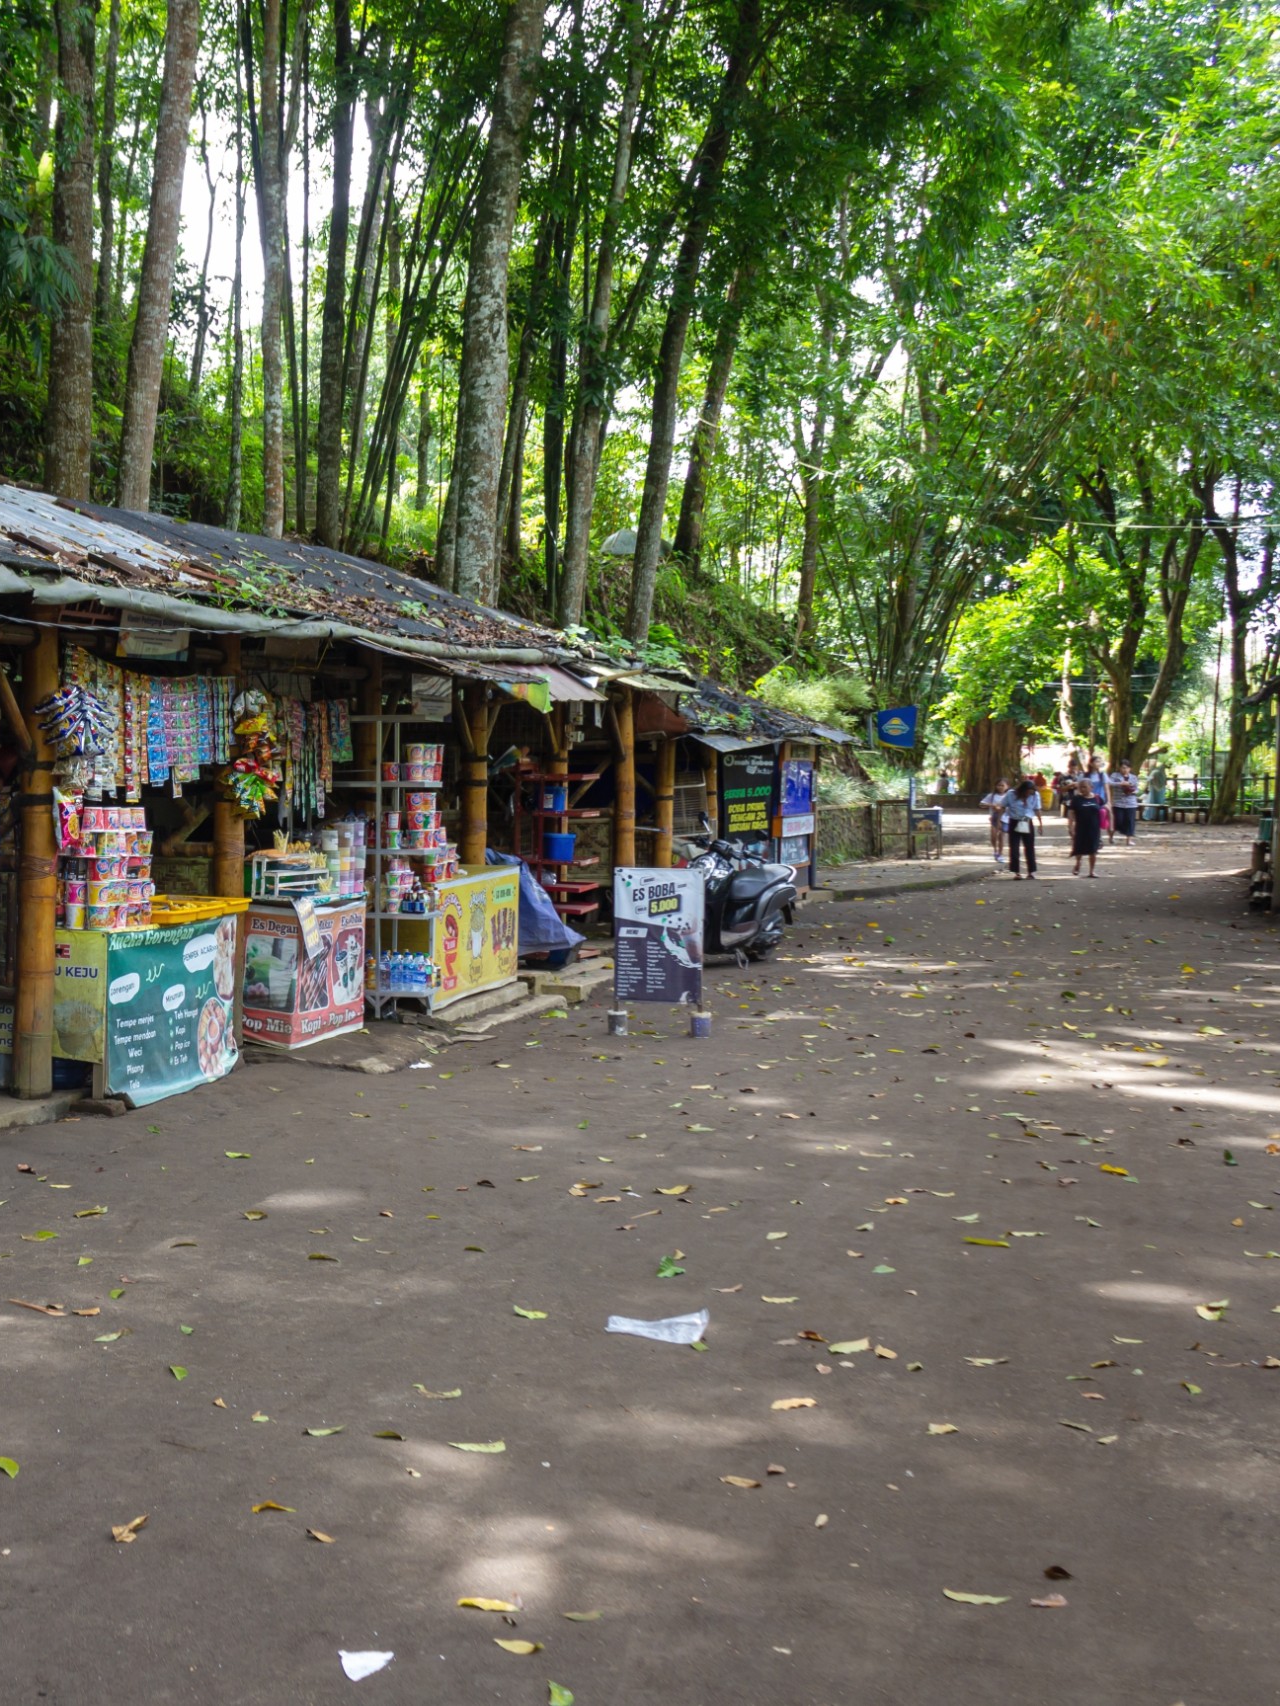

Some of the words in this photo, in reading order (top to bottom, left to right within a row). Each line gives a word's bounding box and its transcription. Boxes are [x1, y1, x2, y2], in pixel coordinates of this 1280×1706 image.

[632, 887, 645, 902] ES
[648, 882, 676, 899] BOBA
[650, 898, 678, 914] 5.000
[252, 918, 266, 930] Es
[267, 920, 298, 935] Degan
[108, 930, 144, 951] Aneka
[144, 927, 195, 946] Gorengan
[65, 966, 98, 979] KEJU
[174, 1010, 183, 1020] Teh
[116, 1018, 136, 1028] Tempe
[242, 1015, 263, 1030] Pop
[266, 1018, 293, 1034] Mie
[301, 1015, 322, 1034] Kopi
[328, 1012, 344, 1026] Pop
[175, 1025, 186, 1036] Kopi
[114, 1035, 131, 1046] Tempe
[132, 1029, 157, 1041] mendoan
[128, 1046, 143, 1058] Weci
[174, 1041, 183, 1051] Pop
[174, 1056, 180, 1066] Es
[180, 1053, 188, 1064] Teh
[126, 1064, 144, 1075] Pisang
